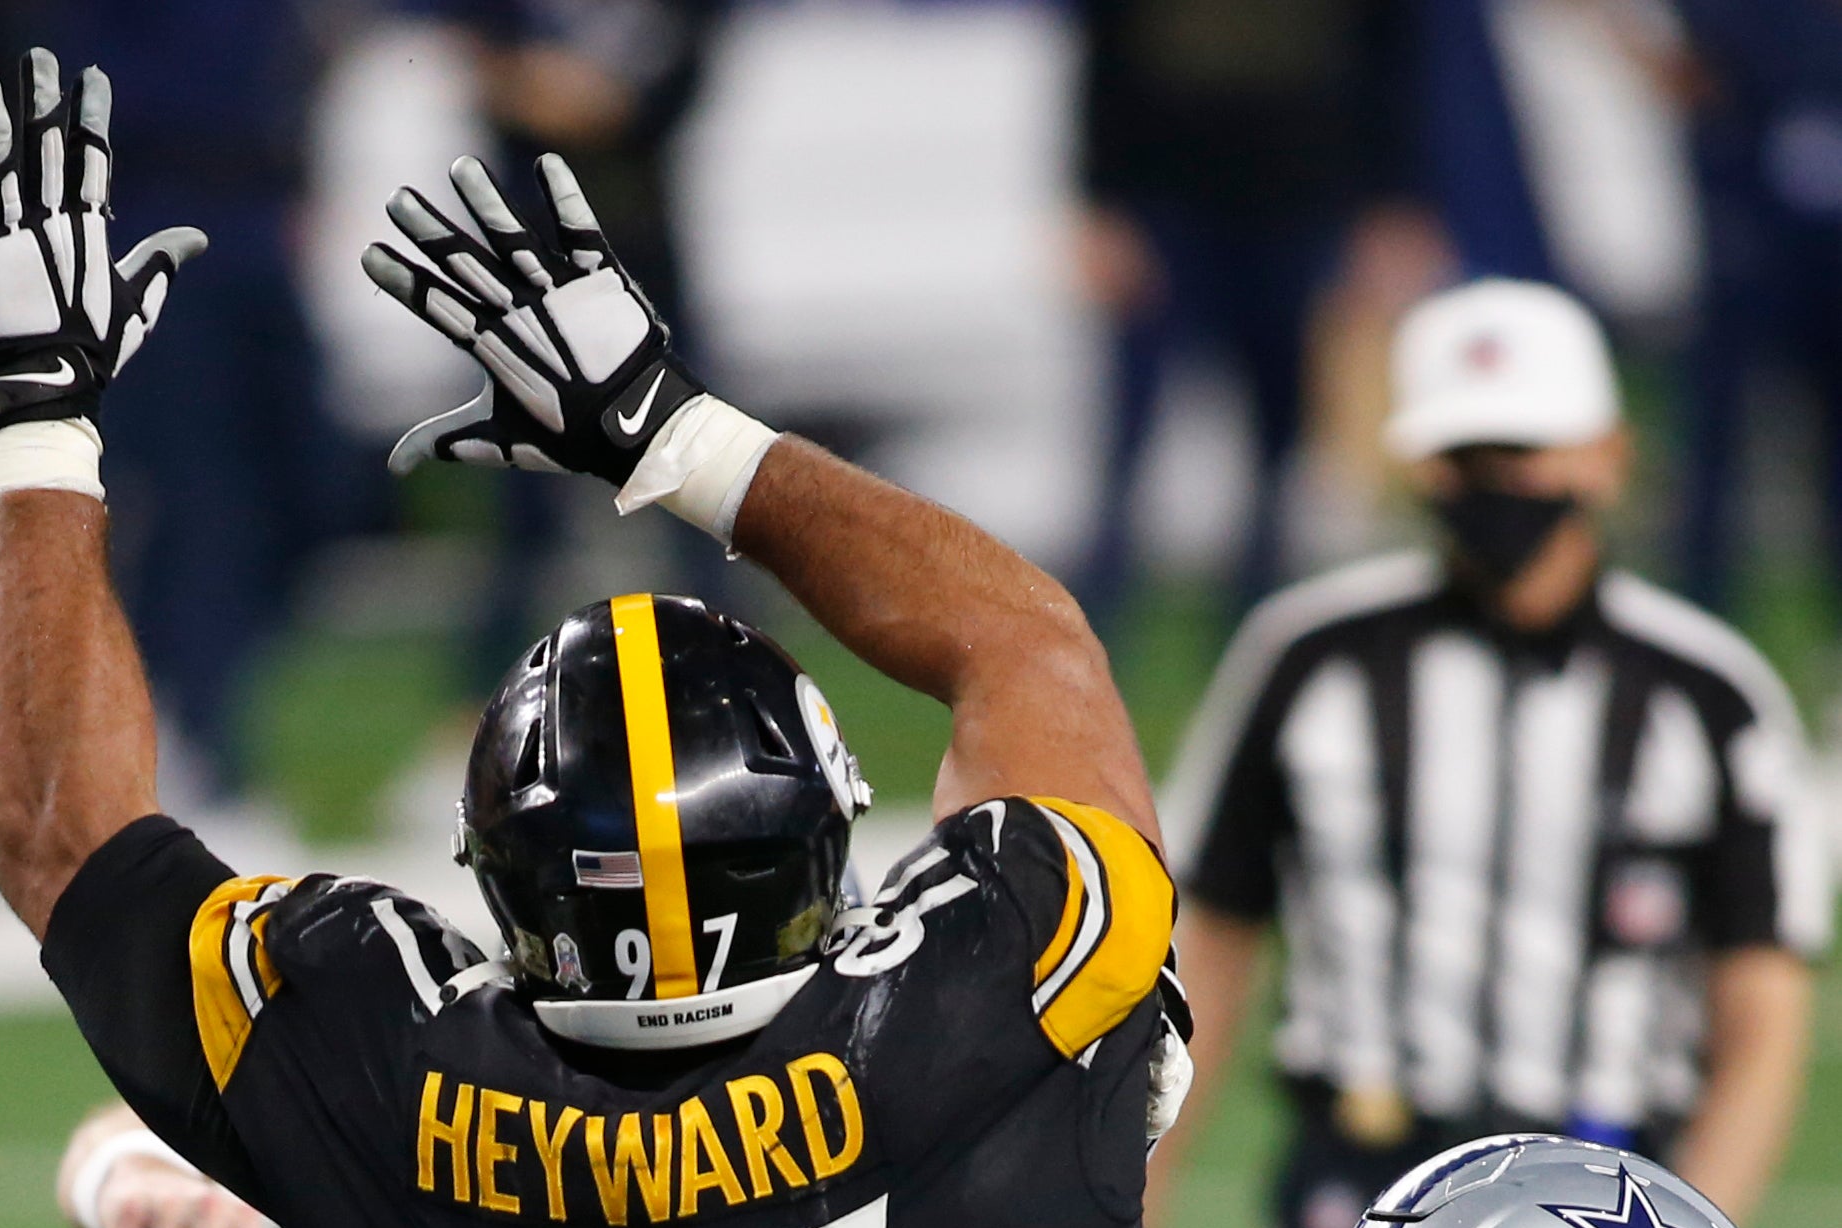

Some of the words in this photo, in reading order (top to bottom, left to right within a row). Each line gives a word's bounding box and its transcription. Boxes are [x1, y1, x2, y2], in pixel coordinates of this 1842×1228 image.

[614, 912, 738, 1000] 97
[637, 1014, 669, 1028] END
[674, 1003, 733, 1026] RACISM
[417, 1052, 865, 1226] HEYWARD
